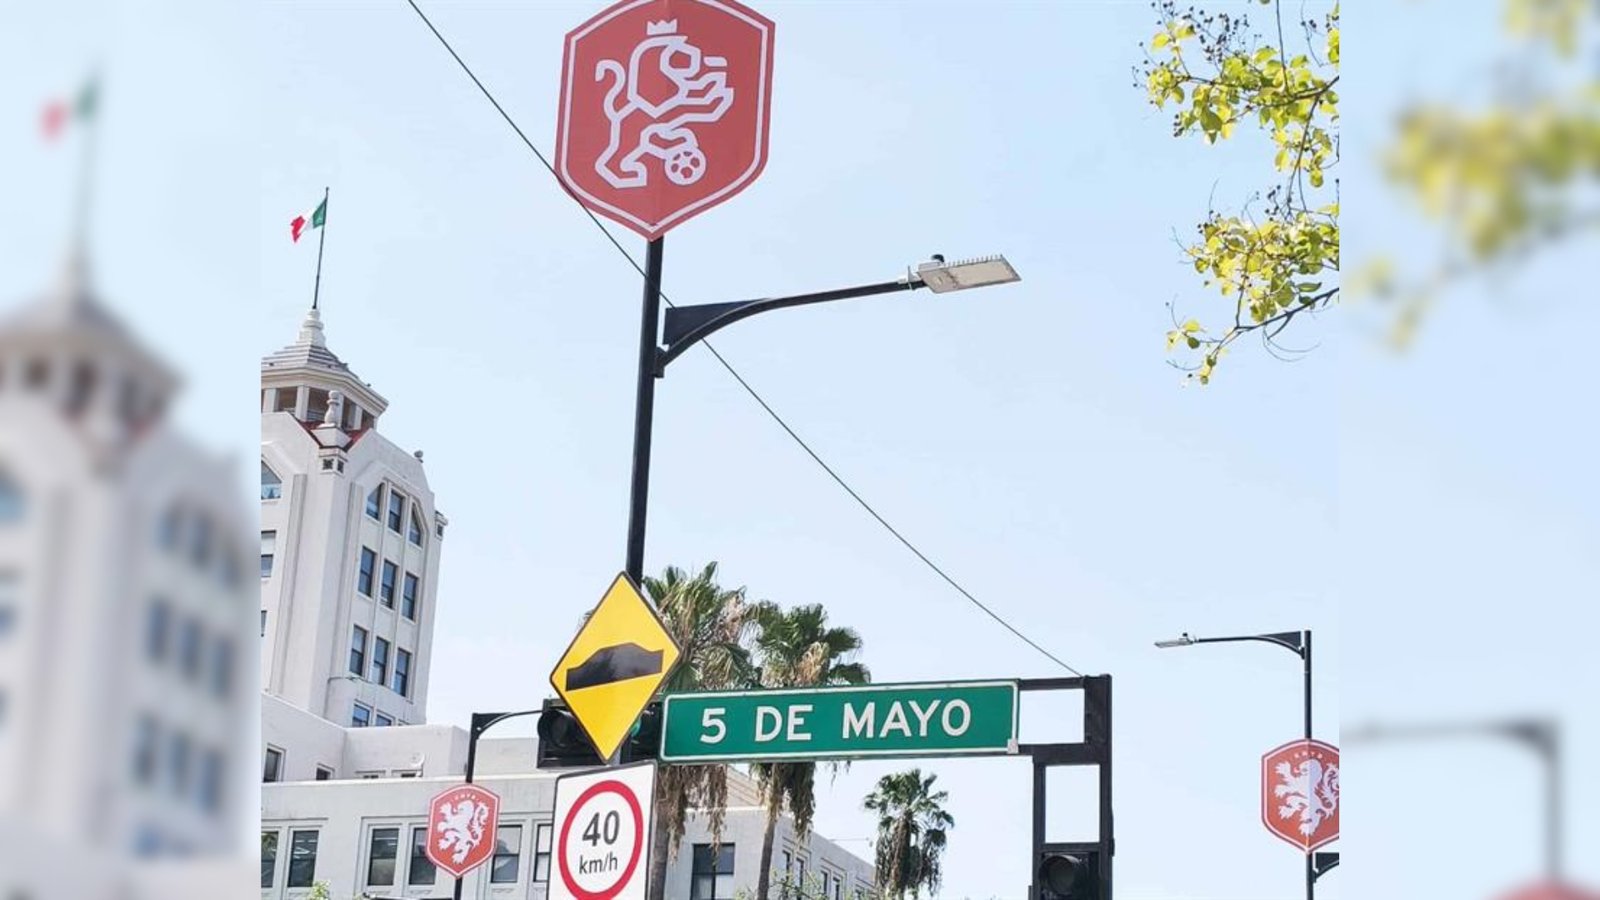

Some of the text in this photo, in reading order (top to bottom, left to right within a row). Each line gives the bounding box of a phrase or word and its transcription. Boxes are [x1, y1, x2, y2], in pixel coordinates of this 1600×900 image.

[700, 698, 971, 744] 5 DE MAYO
[582, 809, 620, 847] 40
[578, 851, 619, 875] km/h
